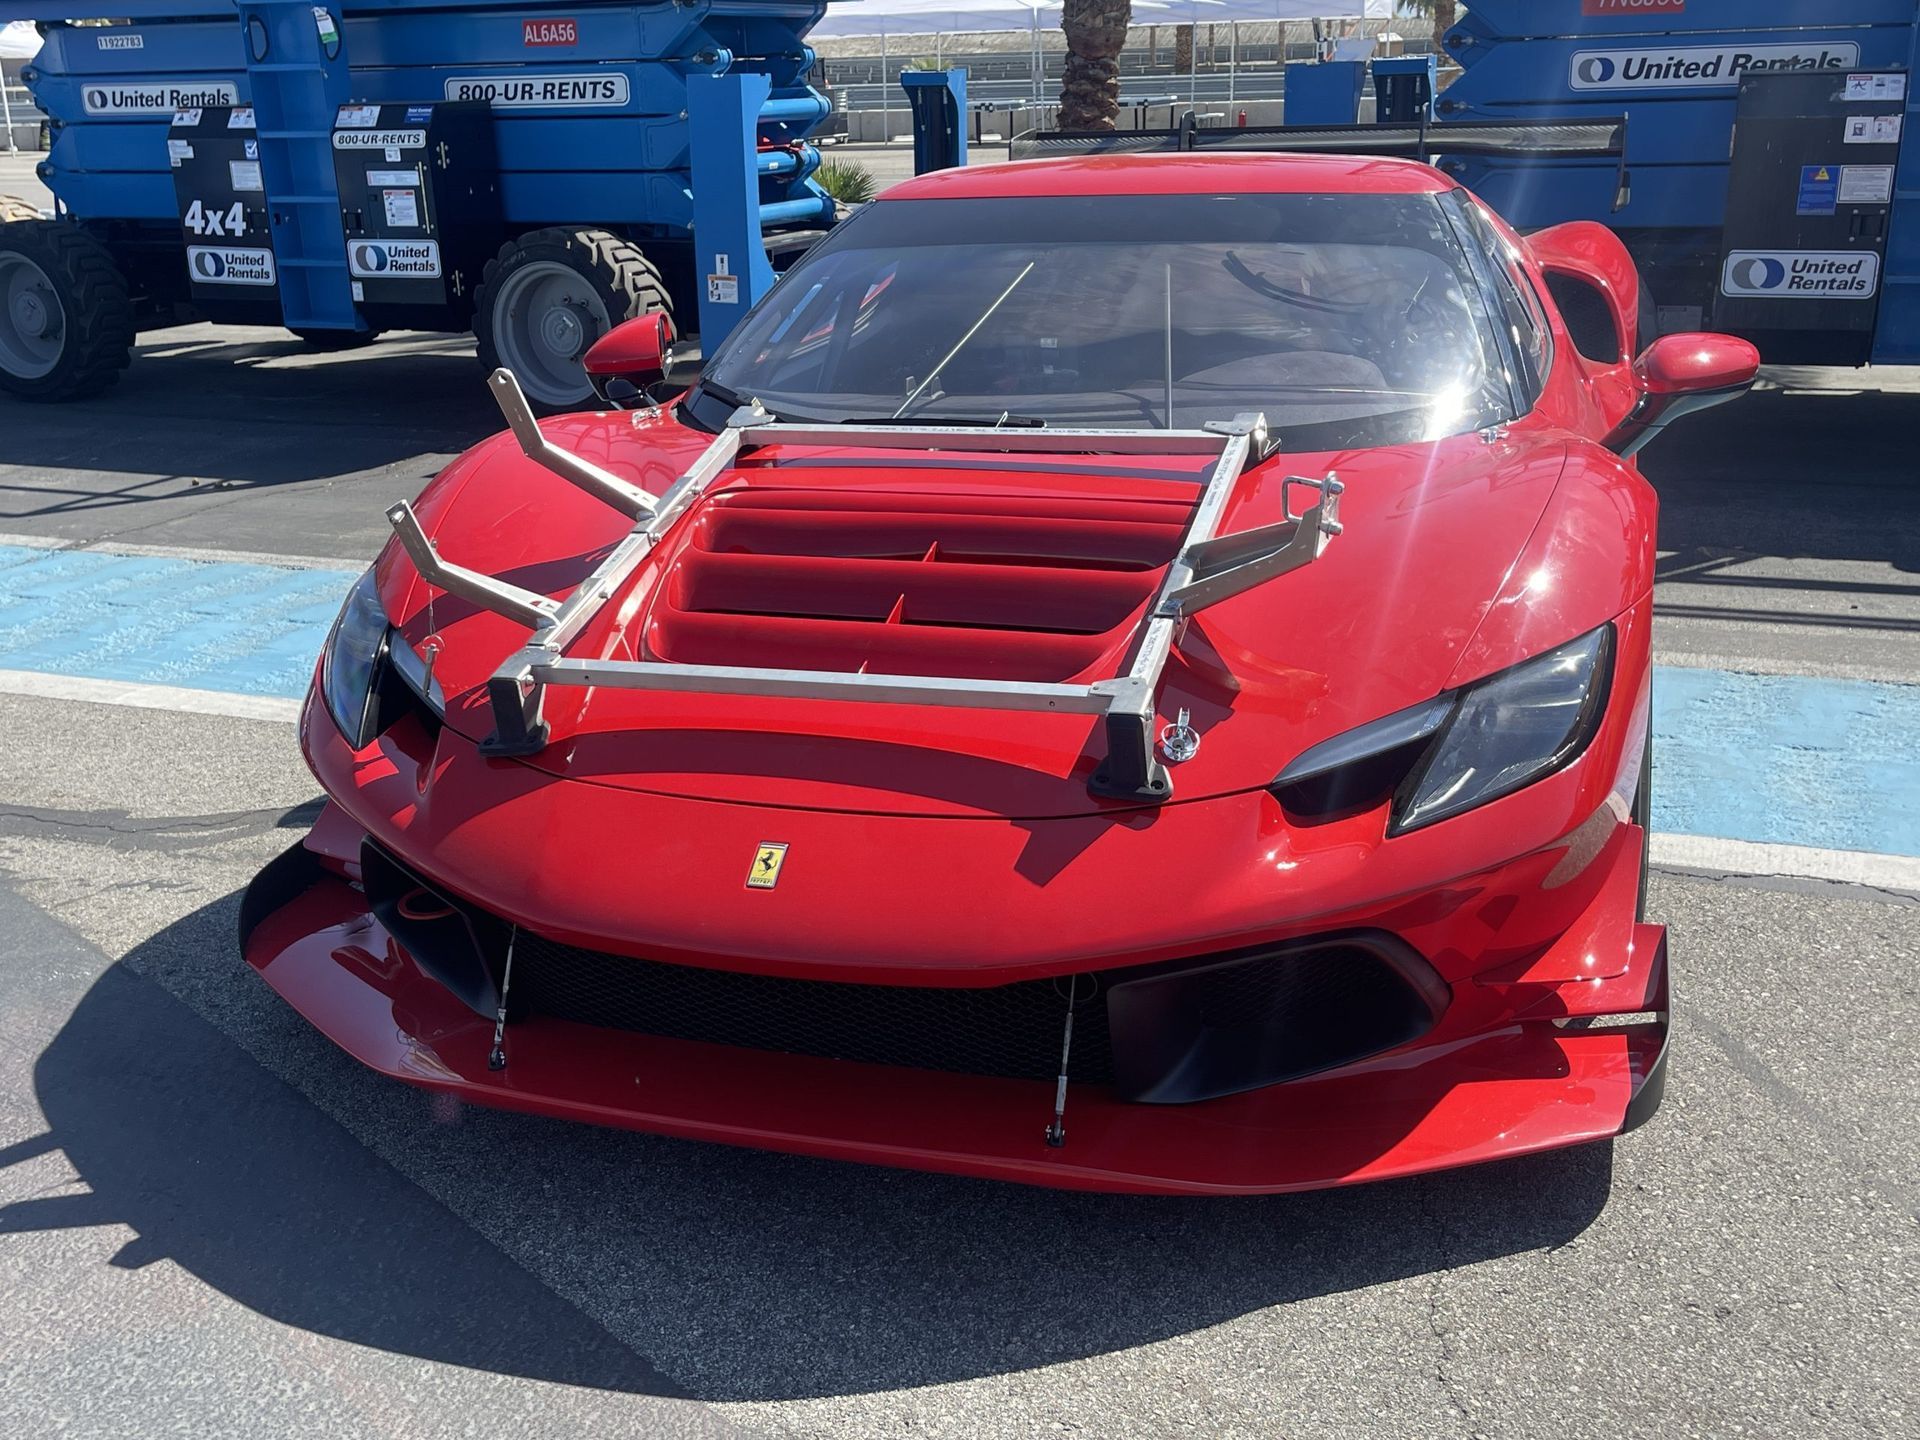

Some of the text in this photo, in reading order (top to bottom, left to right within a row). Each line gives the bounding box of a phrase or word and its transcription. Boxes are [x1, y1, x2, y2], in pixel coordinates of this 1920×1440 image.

[525, 24, 575, 42] AL6A56
[1622, 51, 1842, 81] United Rentals
[459, 80, 615, 100] 800-UR-RENTS
[112, 88, 230, 108] United Rentals
[338, 134, 420, 144] 800-UR-RENTS
[185, 200, 246, 236] 4x4
[388, 246, 430, 258] United
[226, 254, 264, 266] United
[390, 260, 436, 272] Rentals
[1791, 260, 1862, 274] United
[228, 266, 270, 280] Rentals
[1788, 275, 1866, 290] Rentals
